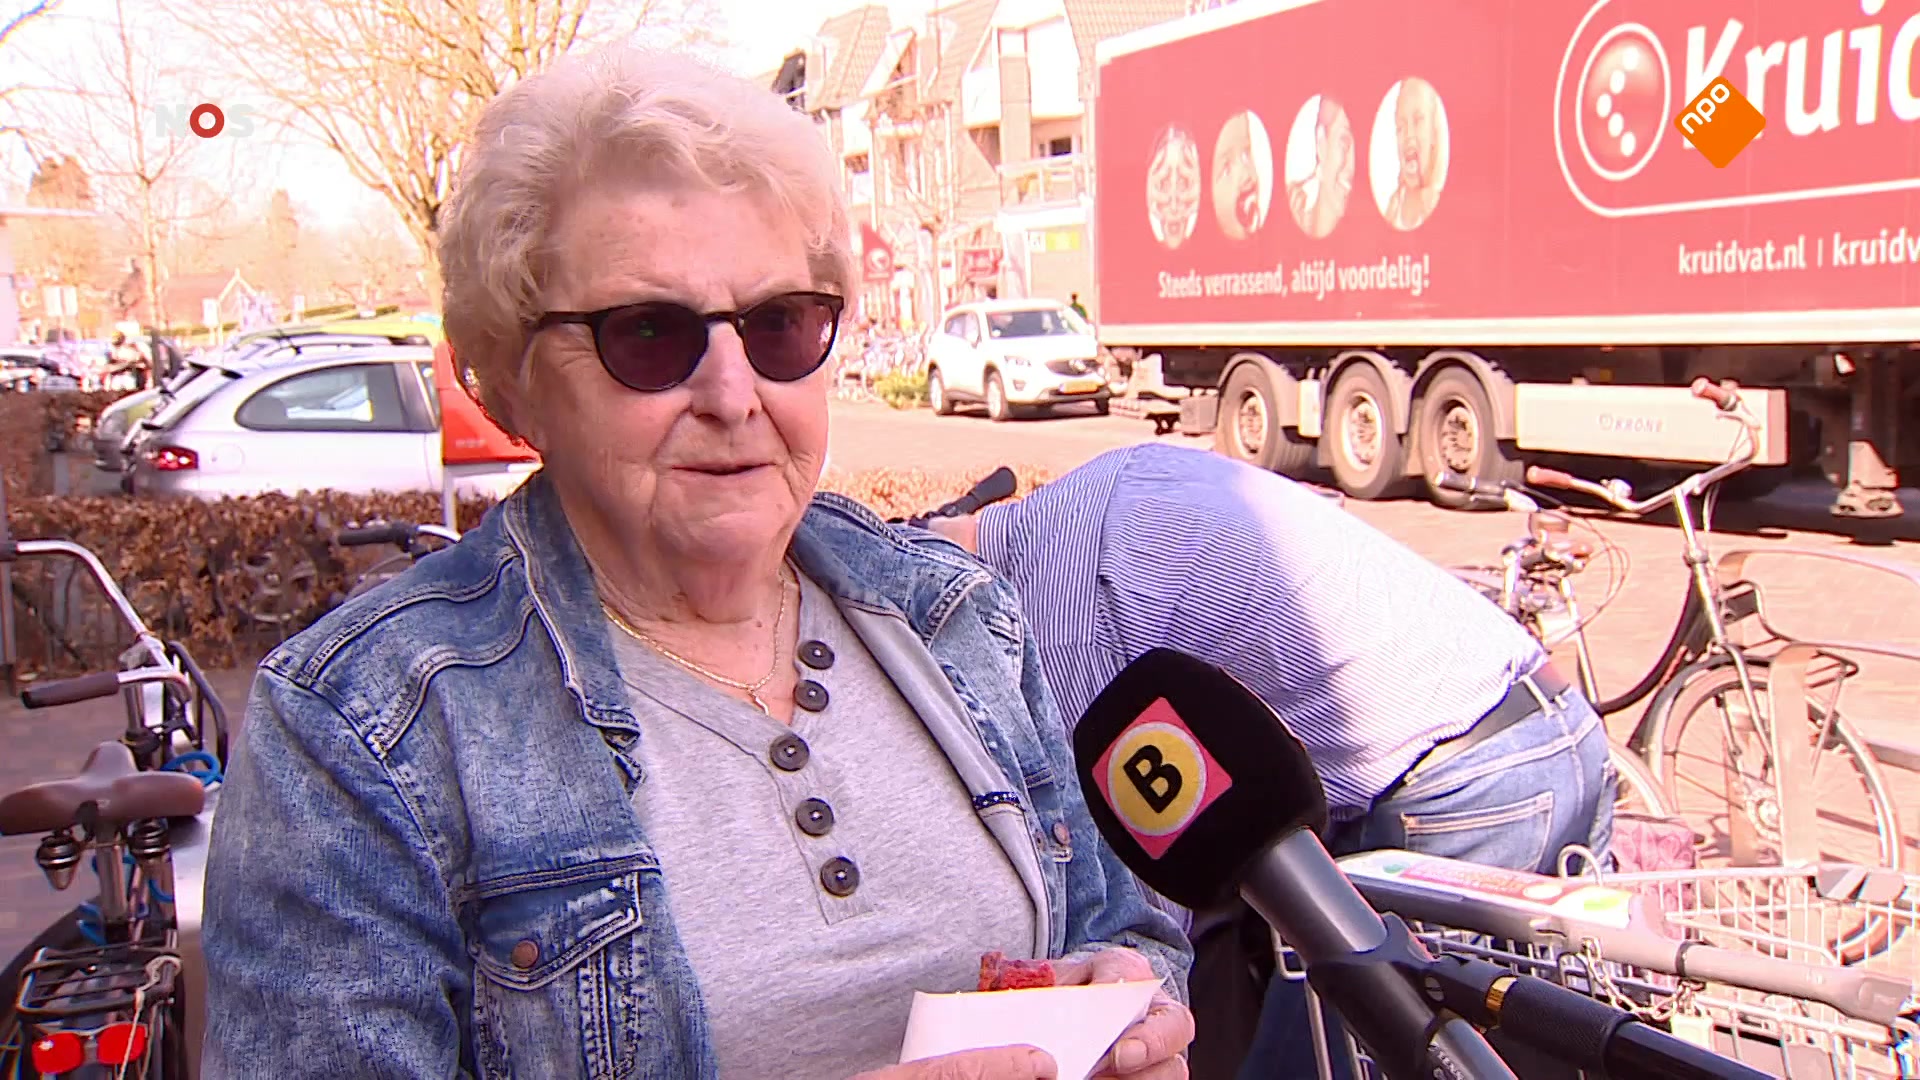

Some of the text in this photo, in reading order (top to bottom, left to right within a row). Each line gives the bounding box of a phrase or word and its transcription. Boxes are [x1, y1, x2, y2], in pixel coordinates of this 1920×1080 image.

[1158, 253, 1430, 301] Steeds verrassend, altijd voordelig!
[1679, 234, 1806, 274] kruidvat.nl
[1123, 745, 1183, 814] B
